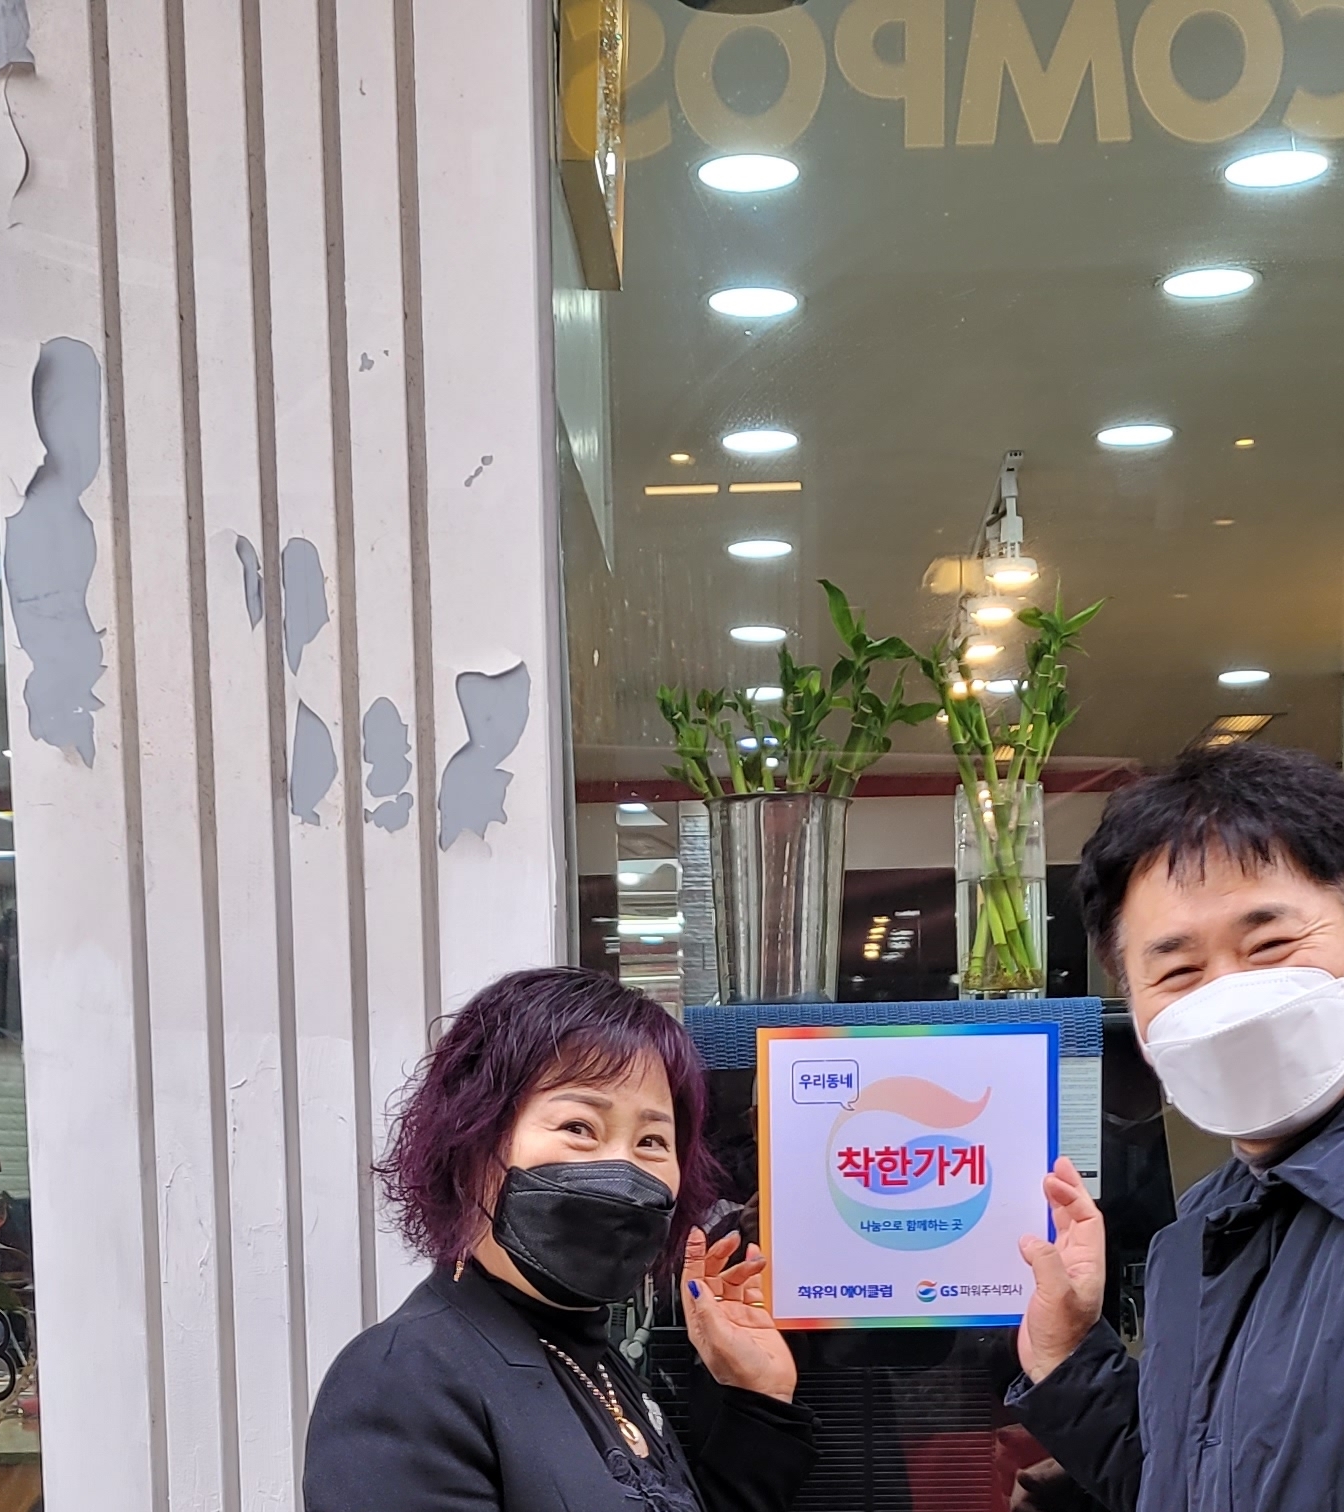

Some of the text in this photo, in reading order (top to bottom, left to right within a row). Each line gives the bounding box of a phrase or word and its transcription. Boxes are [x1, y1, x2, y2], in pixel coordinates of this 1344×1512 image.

[798, 1072, 853, 1090] 우리동네
[836, 1144, 987, 1188] 착한가게
[859, 1218, 963, 1233] 나눔으로 함께하는 곳
